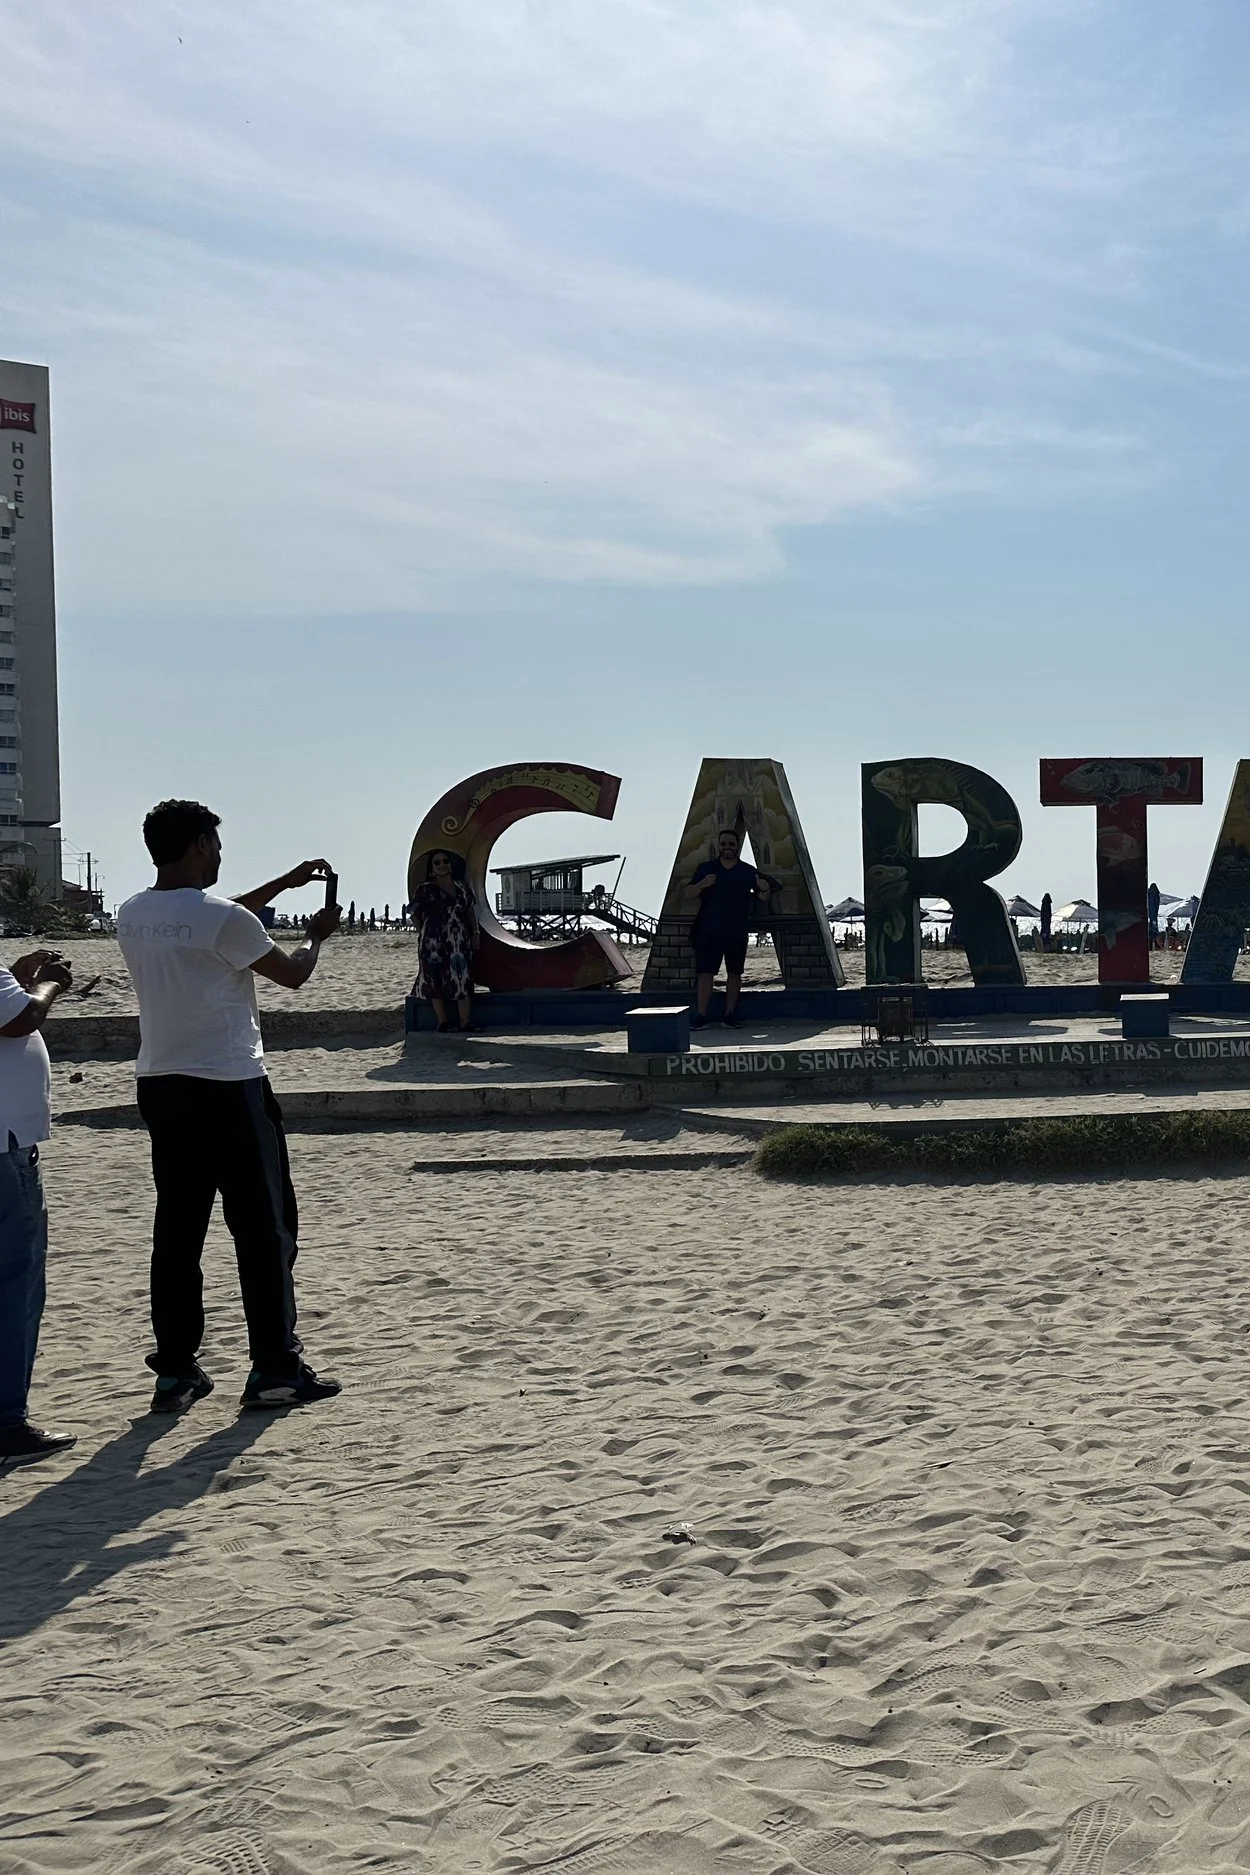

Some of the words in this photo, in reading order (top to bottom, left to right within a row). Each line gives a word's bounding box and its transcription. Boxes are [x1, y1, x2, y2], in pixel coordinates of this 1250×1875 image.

[4, 407, 30, 423] ibis
[12, 441, 25, 519] HOTEL
[152, 919, 192, 940] Klein
[666, 1053, 785, 1075] PROHIBIDO
[1019, 1046, 1044, 1064] EN
[1049, 1044, 1085, 1064] LAS
